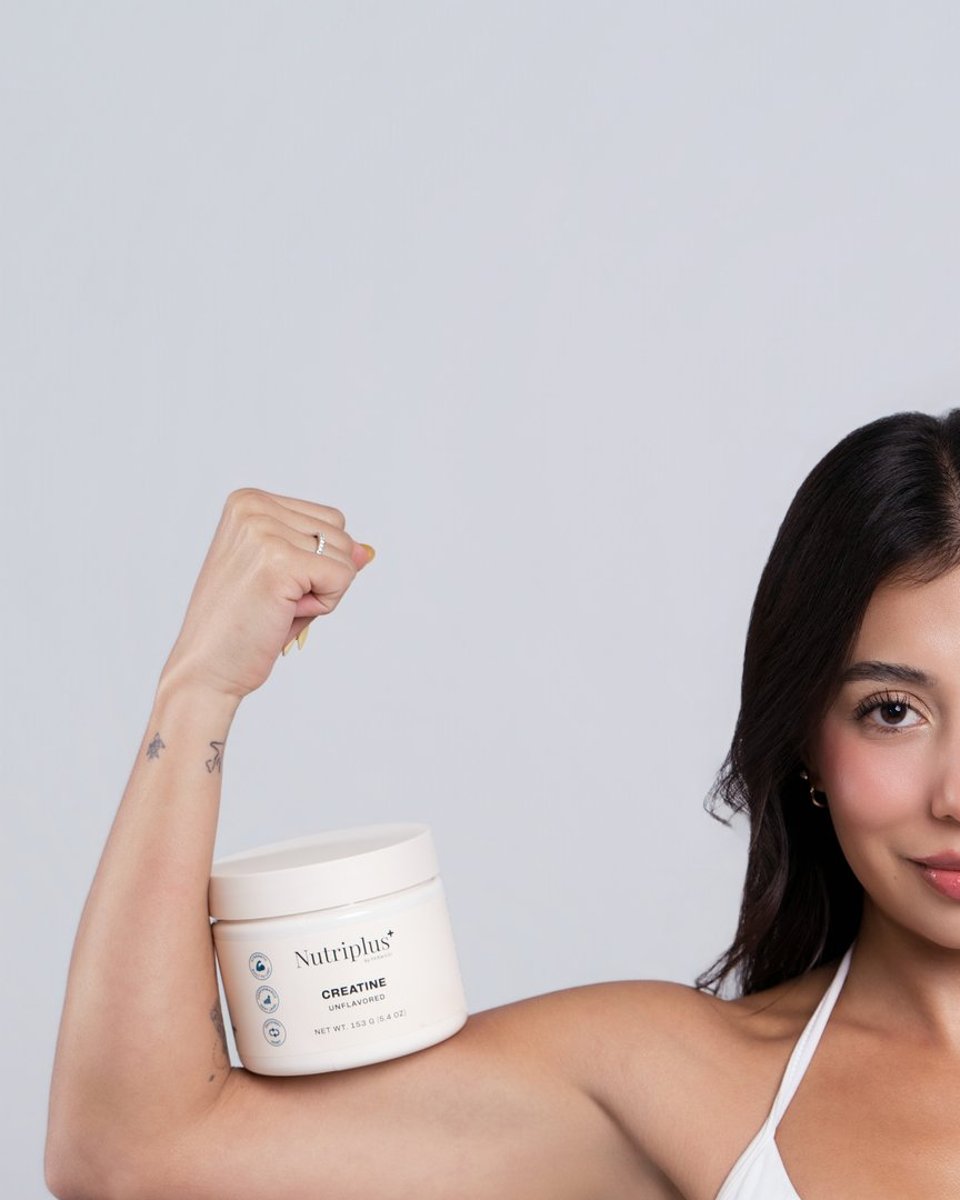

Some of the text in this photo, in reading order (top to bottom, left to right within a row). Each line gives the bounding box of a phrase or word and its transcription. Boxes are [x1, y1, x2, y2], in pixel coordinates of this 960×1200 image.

[321, 977, 387, 999] CREATINE
[328, 994, 386, 1011] UNFLAVORED
[314, 1026, 330, 1035] NET
[350, 1020, 366, 1029] 153
